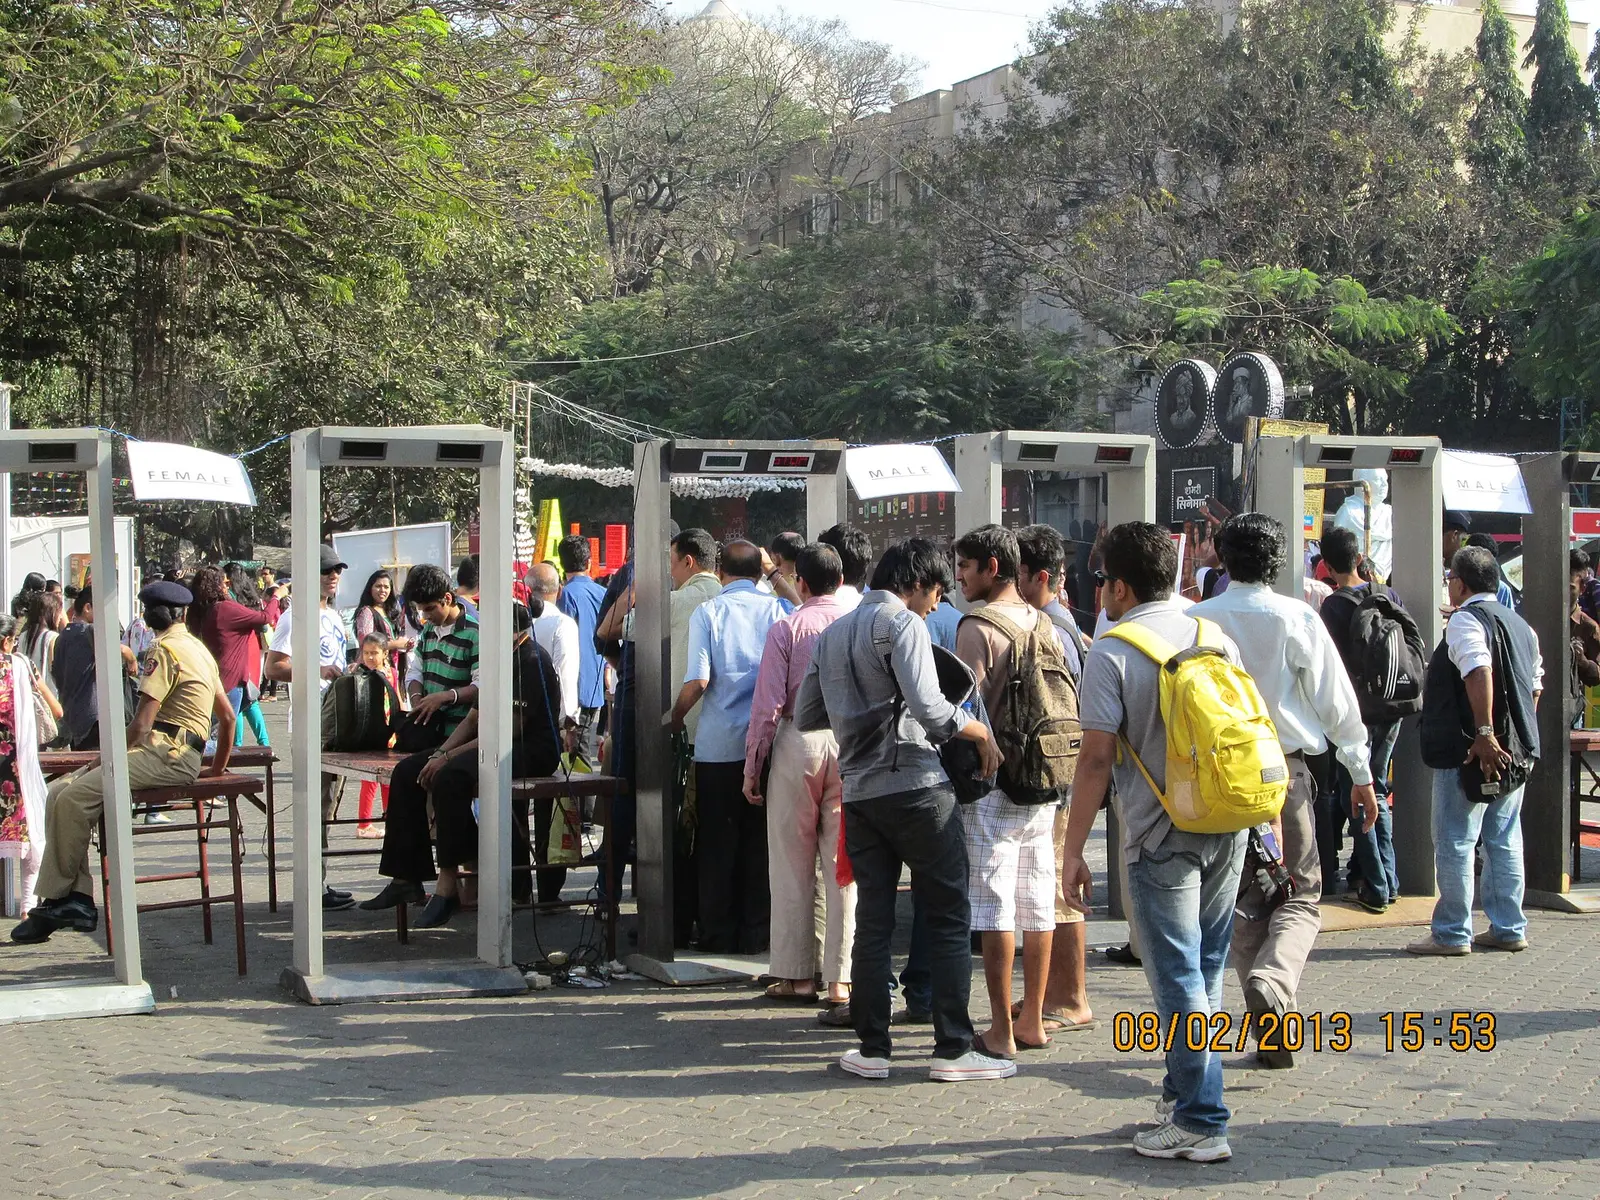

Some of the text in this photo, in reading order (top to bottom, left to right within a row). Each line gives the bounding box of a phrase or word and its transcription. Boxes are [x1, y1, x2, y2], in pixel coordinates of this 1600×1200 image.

[148, 470, 232, 485] FEMALE
[868, 465, 930, 479] MALE
[1456, 479, 1508, 492] MALE
